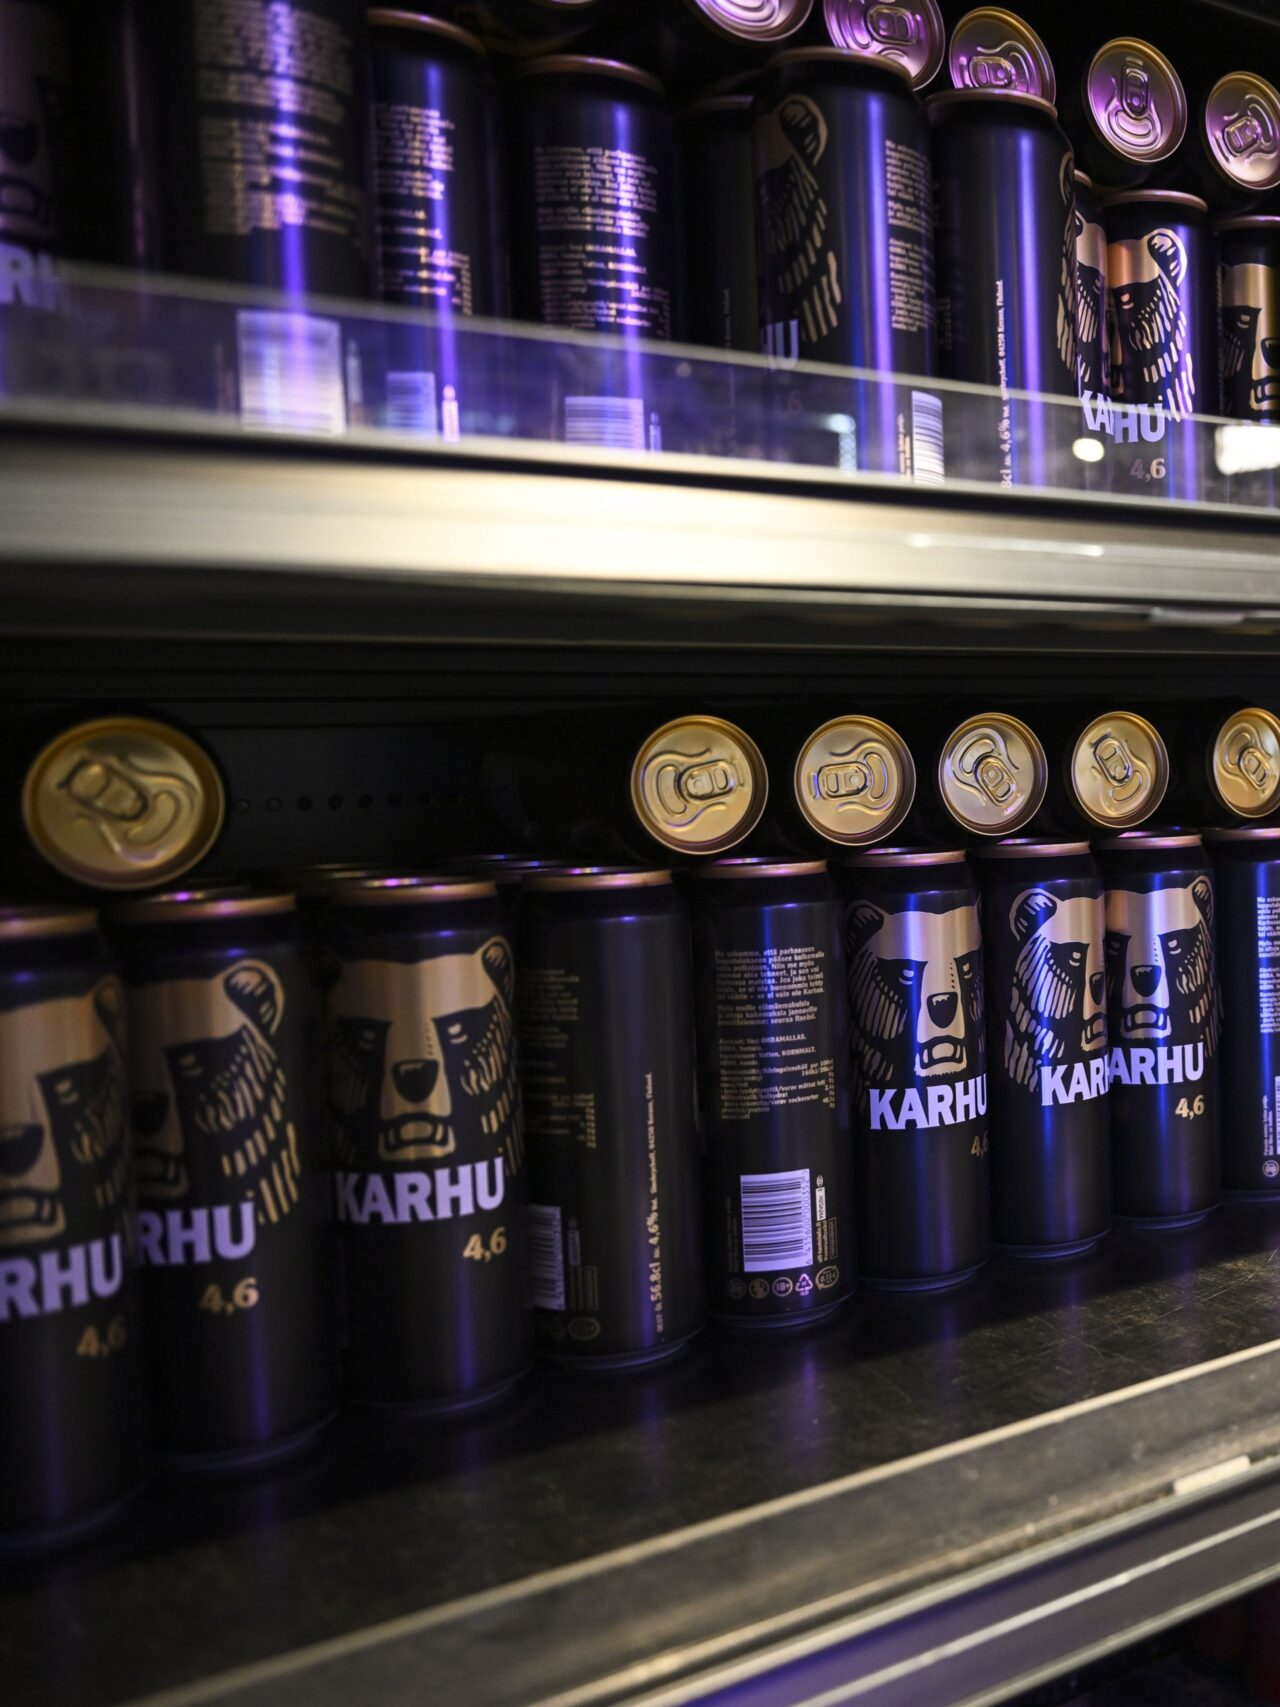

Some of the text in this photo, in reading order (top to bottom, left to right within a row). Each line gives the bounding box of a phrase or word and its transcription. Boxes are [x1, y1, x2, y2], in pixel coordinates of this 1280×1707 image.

[1080, 390, 1114, 436] KA
[1130, 458, 1167, 481] 4,6
[870, 1073, 987, 1130] KARHU
[1175, 1095, 1205, 1120] 4,6
[334, 1157, 505, 1225] KARHU
[463, 1228, 508, 1261] 4,6
[202, 1277, 260, 1315] 4,6
